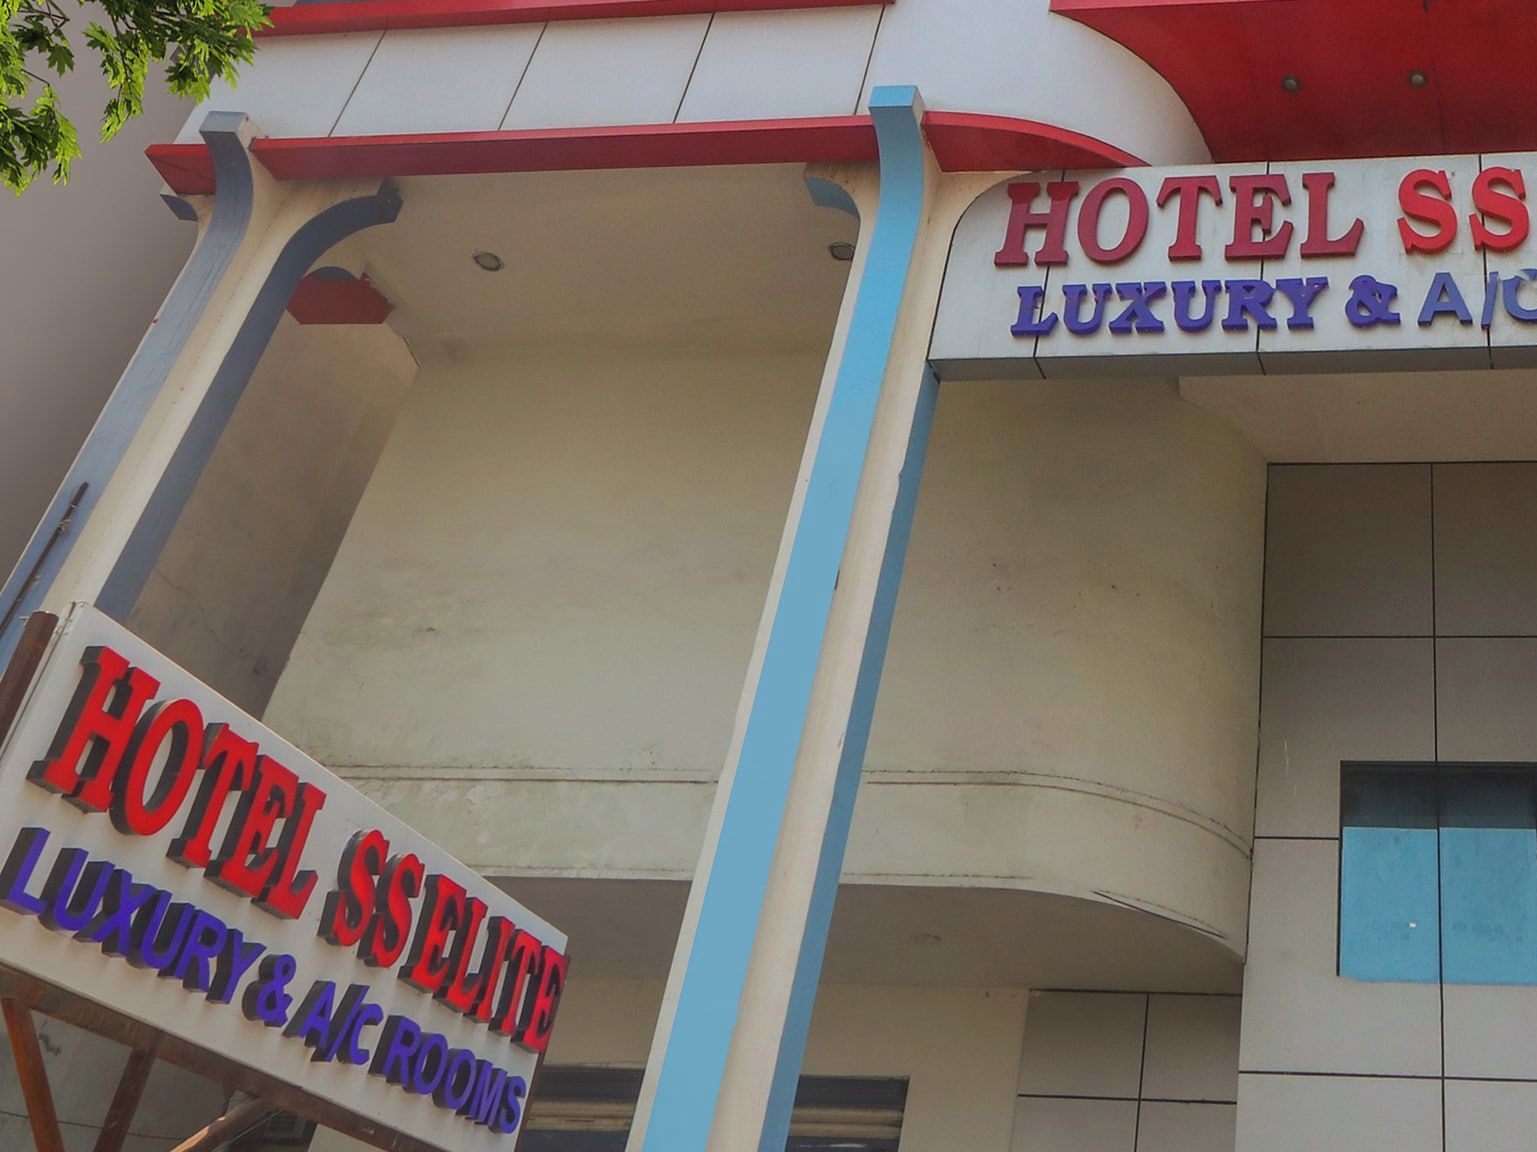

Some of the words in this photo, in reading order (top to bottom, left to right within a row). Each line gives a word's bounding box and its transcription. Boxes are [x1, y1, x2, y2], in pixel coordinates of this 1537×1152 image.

[994, 172, 1364, 266] HOTEL
[1397, 167, 1531, 254] SS
[1011, 276, 1328, 337] LUXURY
[1345, 275, 1400, 328] &
[28, 645, 326, 919] HOTEL
[400, 874, 568, 1051] ELITE
[0, 827, 266, 1004] LUXURY
[242, 953, 297, 1027] &
[283, 980, 383, 1065] A/C
[369, 1015, 526, 1133] ROOMS
